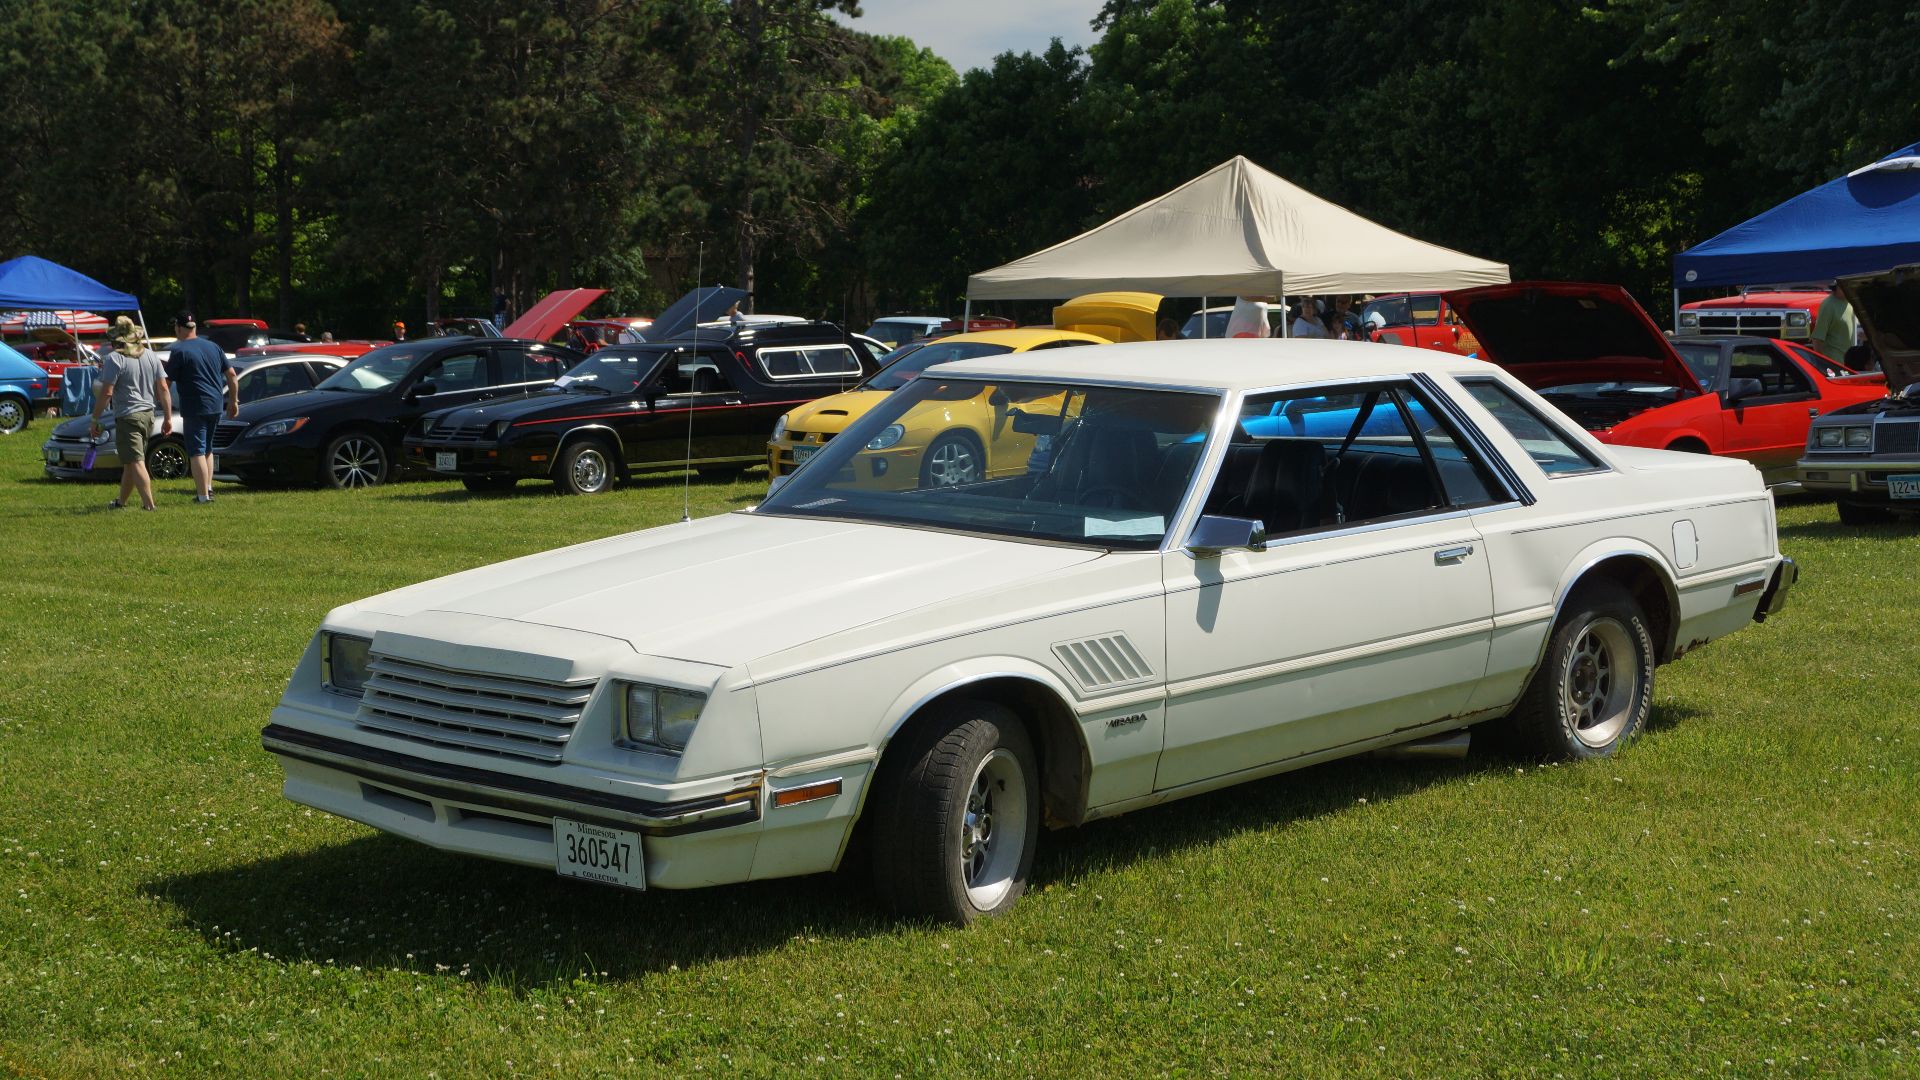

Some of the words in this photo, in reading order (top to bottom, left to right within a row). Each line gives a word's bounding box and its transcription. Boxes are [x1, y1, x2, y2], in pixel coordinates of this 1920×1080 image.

[1631, 616, 1651, 678] COOPER
[1630, 683, 1651, 738] COBRA
[577, 822, 617, 840] Minnesota
[566, 833, 631, 874] 360547
[582, 871, 619, 883] COLLECTOR
